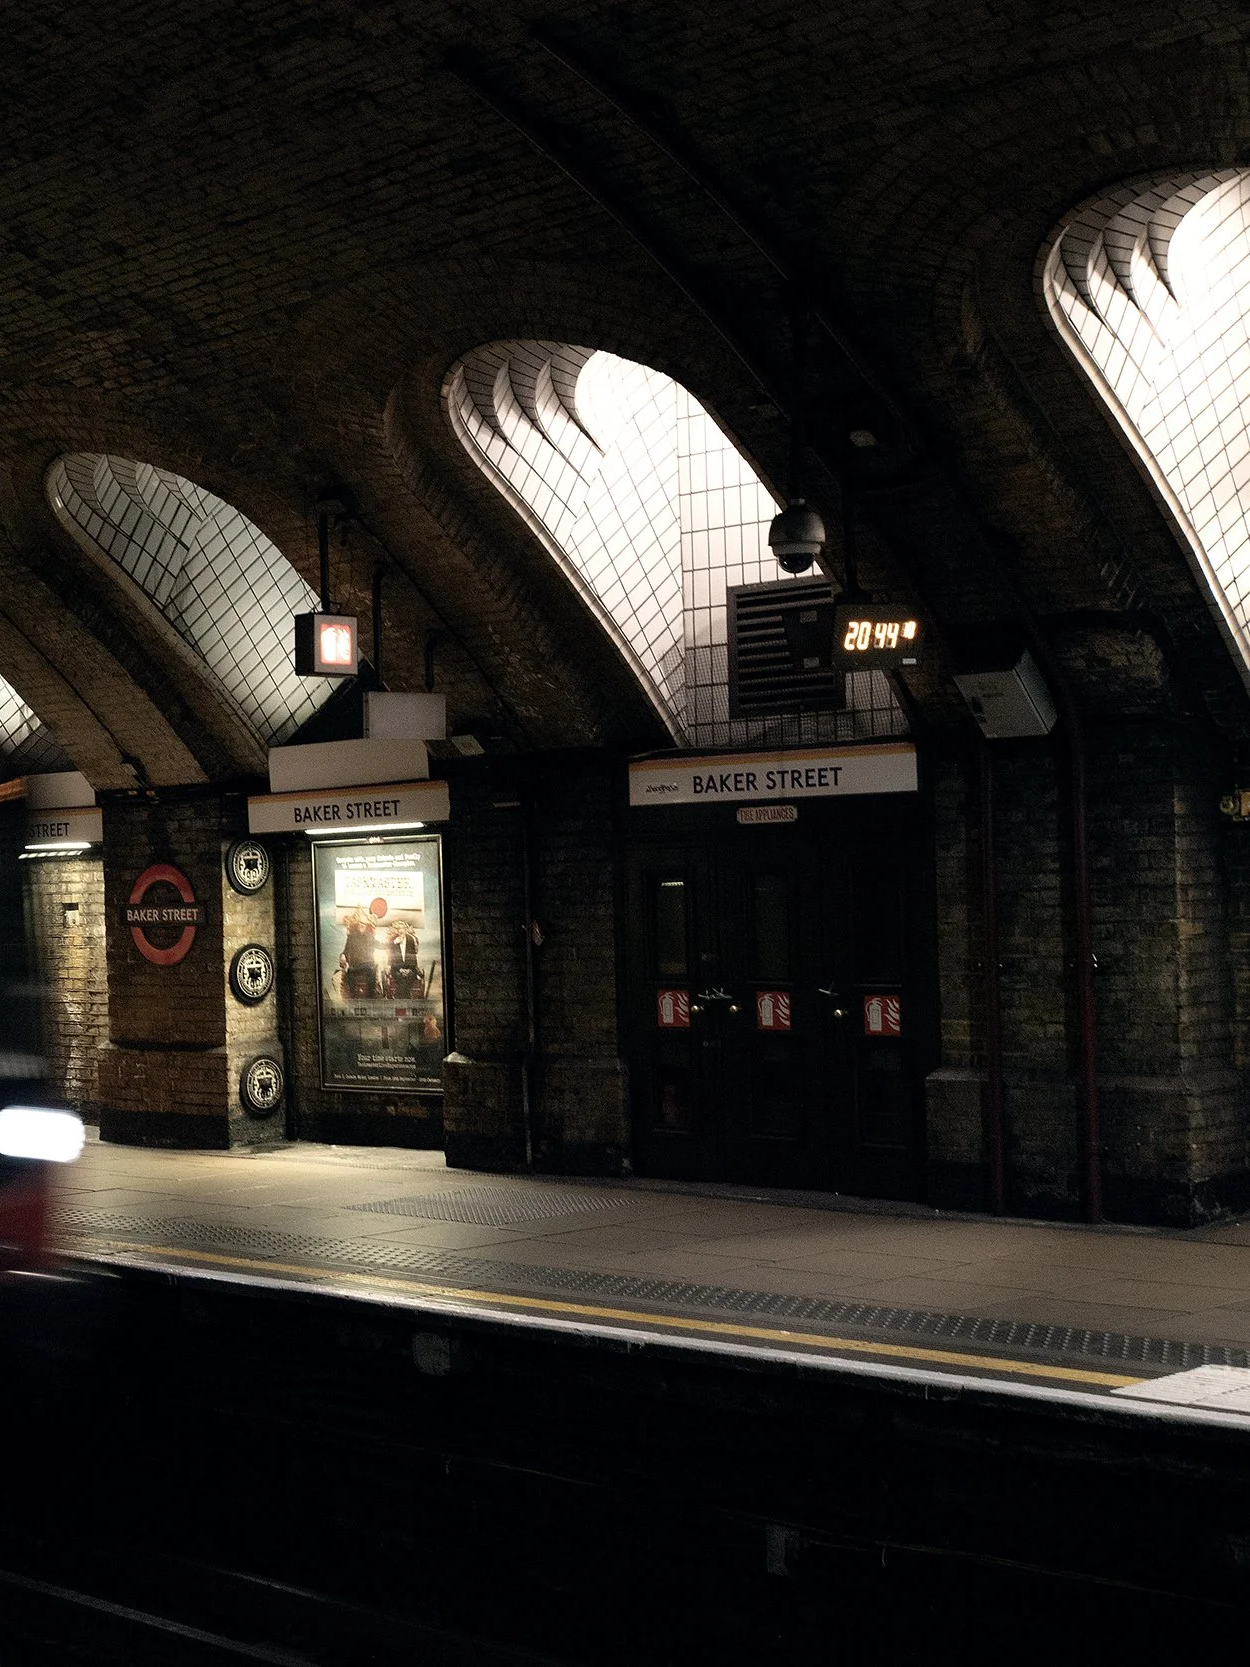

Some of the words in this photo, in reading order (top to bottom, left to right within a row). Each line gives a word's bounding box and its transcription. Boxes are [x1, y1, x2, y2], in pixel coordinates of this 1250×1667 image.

[692, 772, 759, 794] BAKER
[765, 766, 843, 790] STREET
[293, 804, 342, 824] BAKER
[346, 799, 401, 820] STREET
[29, 822, 70, 839] STREET
[126, 909, 160, 921] BAKER
[162, 908, 199, 921] STREET
